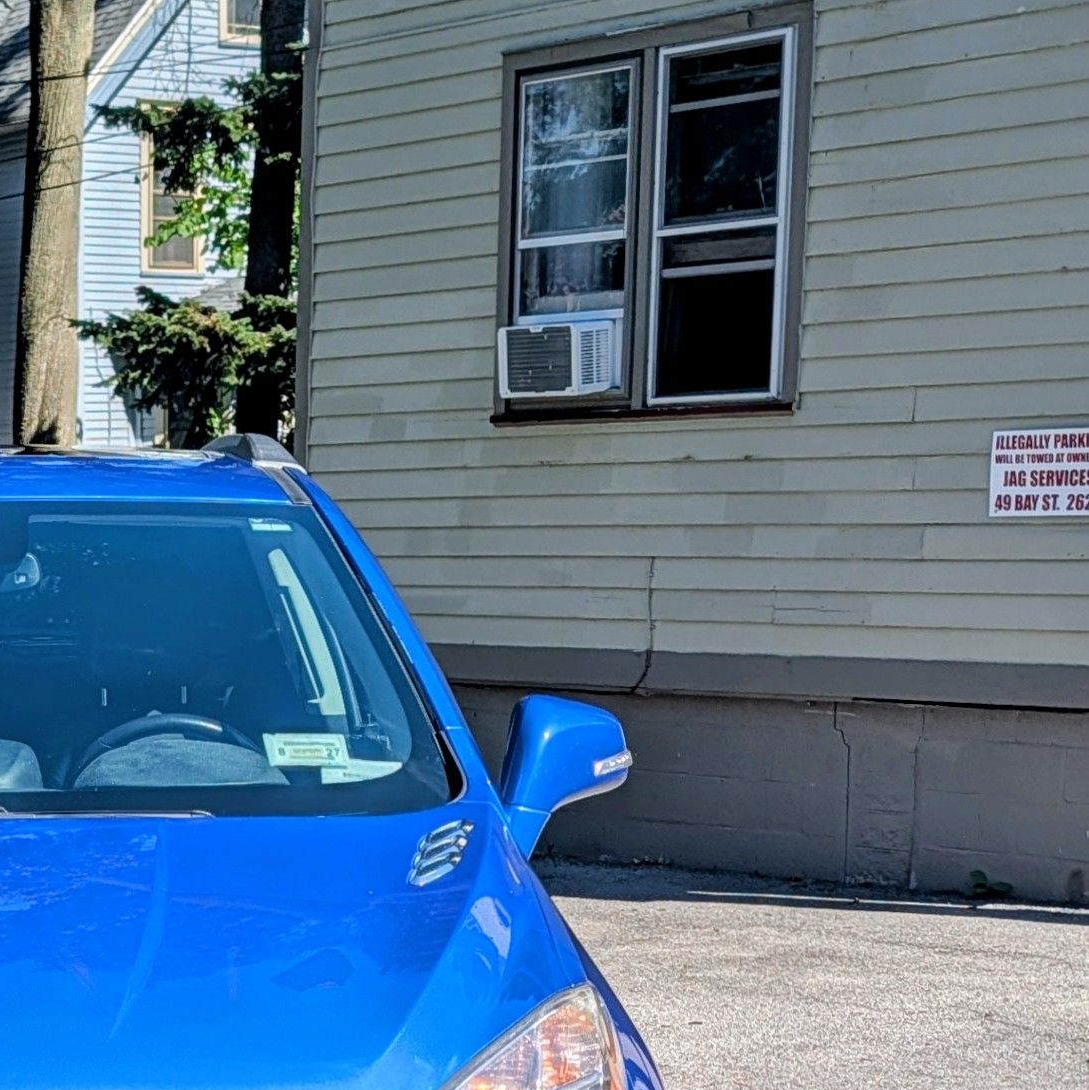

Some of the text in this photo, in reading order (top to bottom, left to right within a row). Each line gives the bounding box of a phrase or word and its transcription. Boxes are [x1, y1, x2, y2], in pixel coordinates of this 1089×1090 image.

[996, 434, 1051, 450] ILLEGALLY
[995, 454, 1013, 464] WILL
[1015, 454, 1024, 464] BE
[1027, 453, 1054, 464] TOWED
[1055, 453, 1065, 463] AT
[1003, 470, 1027, 487] JAG
[994, 494, 1011, 511] 49
[1014, 494, 1039, 511] BAY
[1042, 493, 1060, 511] ST.
